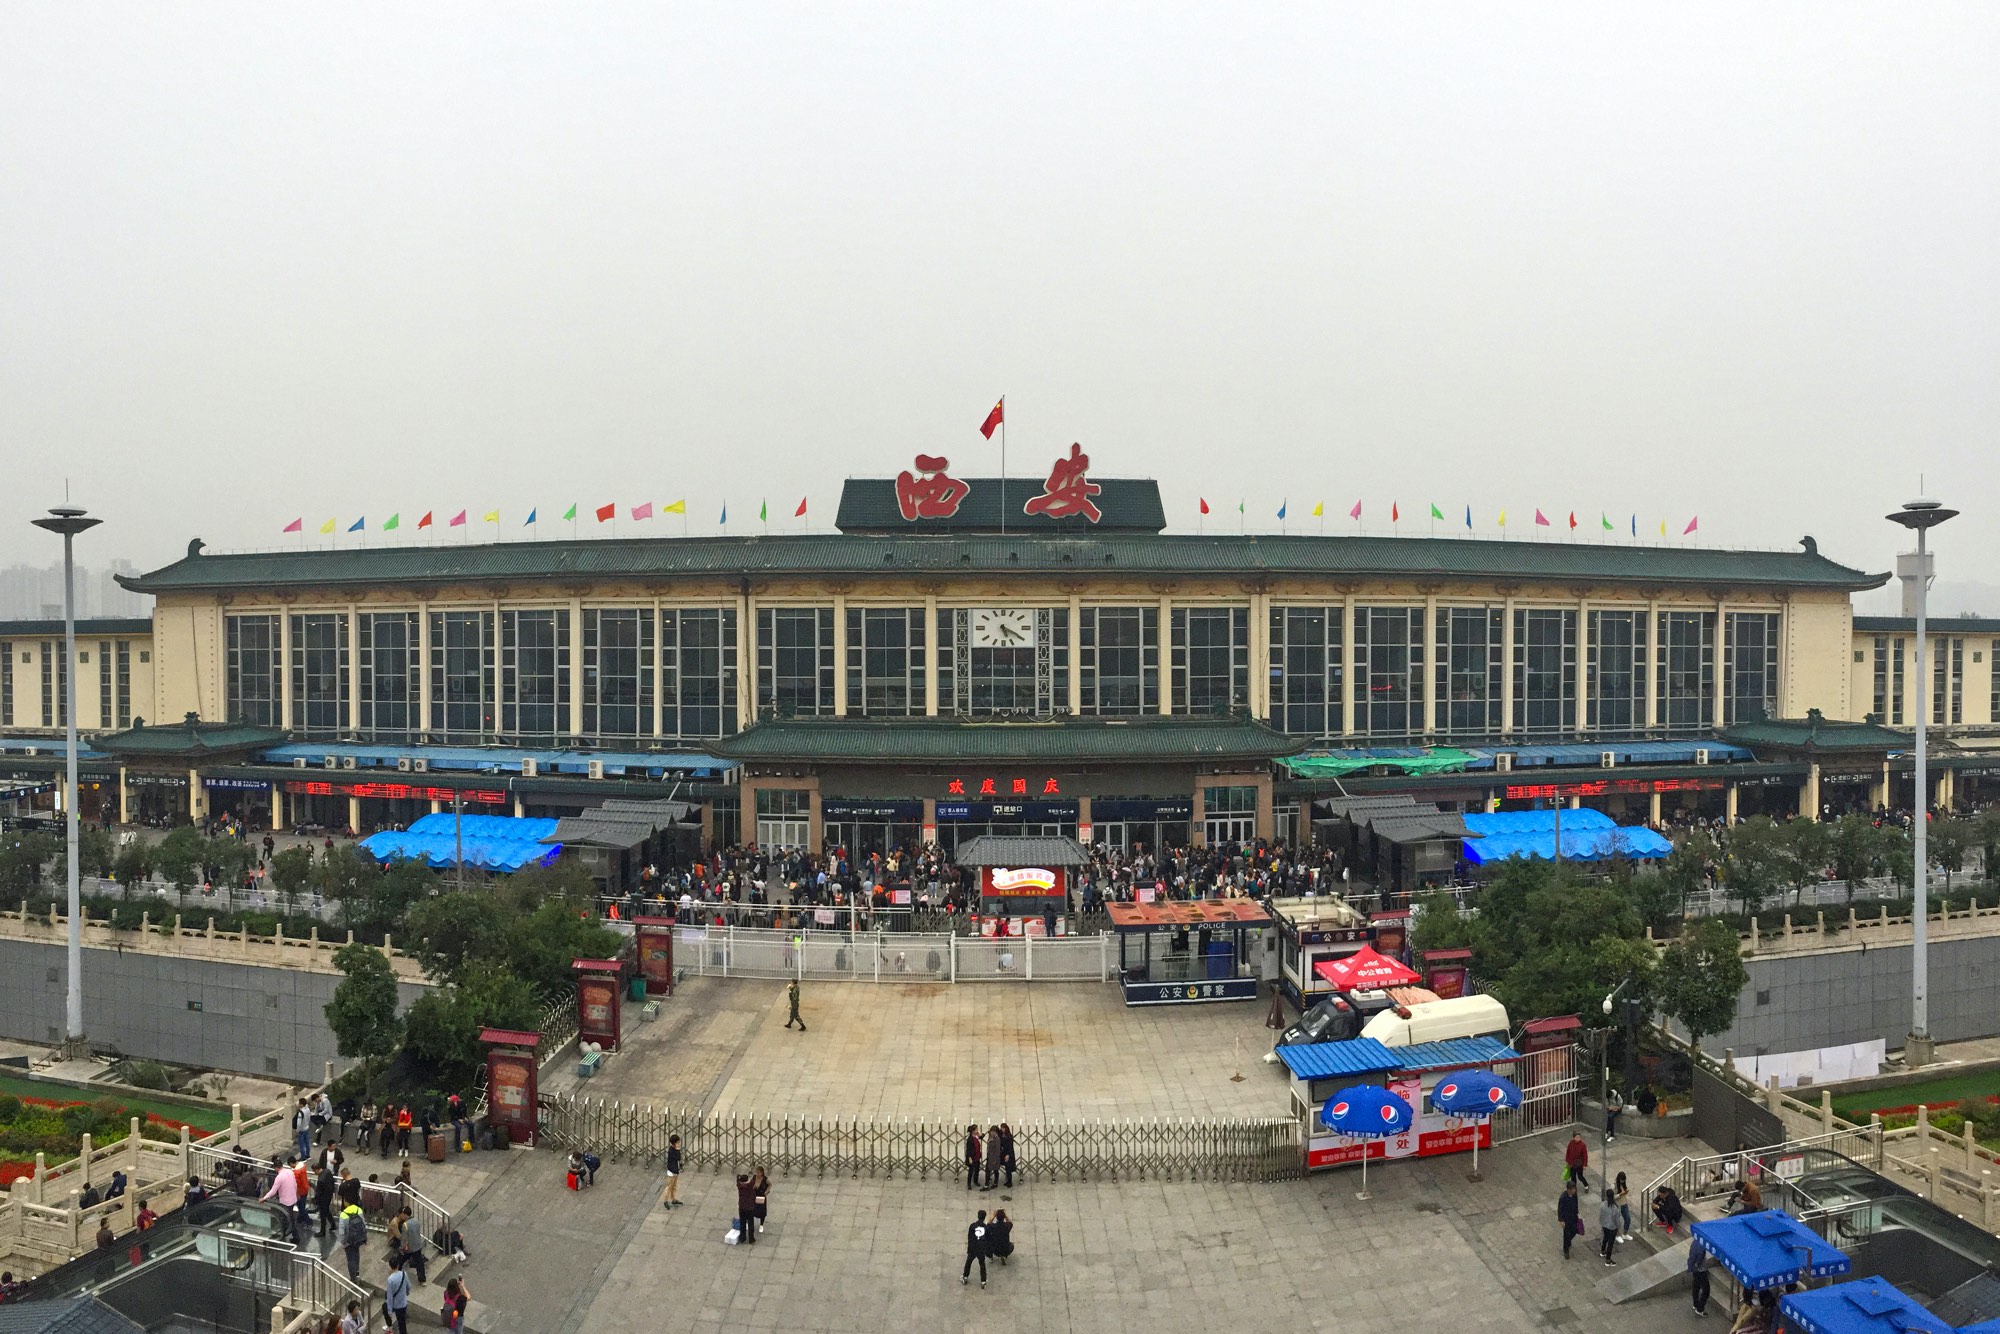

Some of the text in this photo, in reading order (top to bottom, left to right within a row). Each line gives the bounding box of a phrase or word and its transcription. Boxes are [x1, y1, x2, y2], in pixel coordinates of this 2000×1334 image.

[895, 442, 1102, 524] 西安
[949, 778, 1060, 794] 欢度国庆
[1003, 805, 1023, 813] 进站口
[1323, 931, 1356, 942] 公安
[1357, 968, 1393, 977] 中公教育
[1159, 987, 1182, 998] 公安
[1202, 985, 1225, 997] 警察
